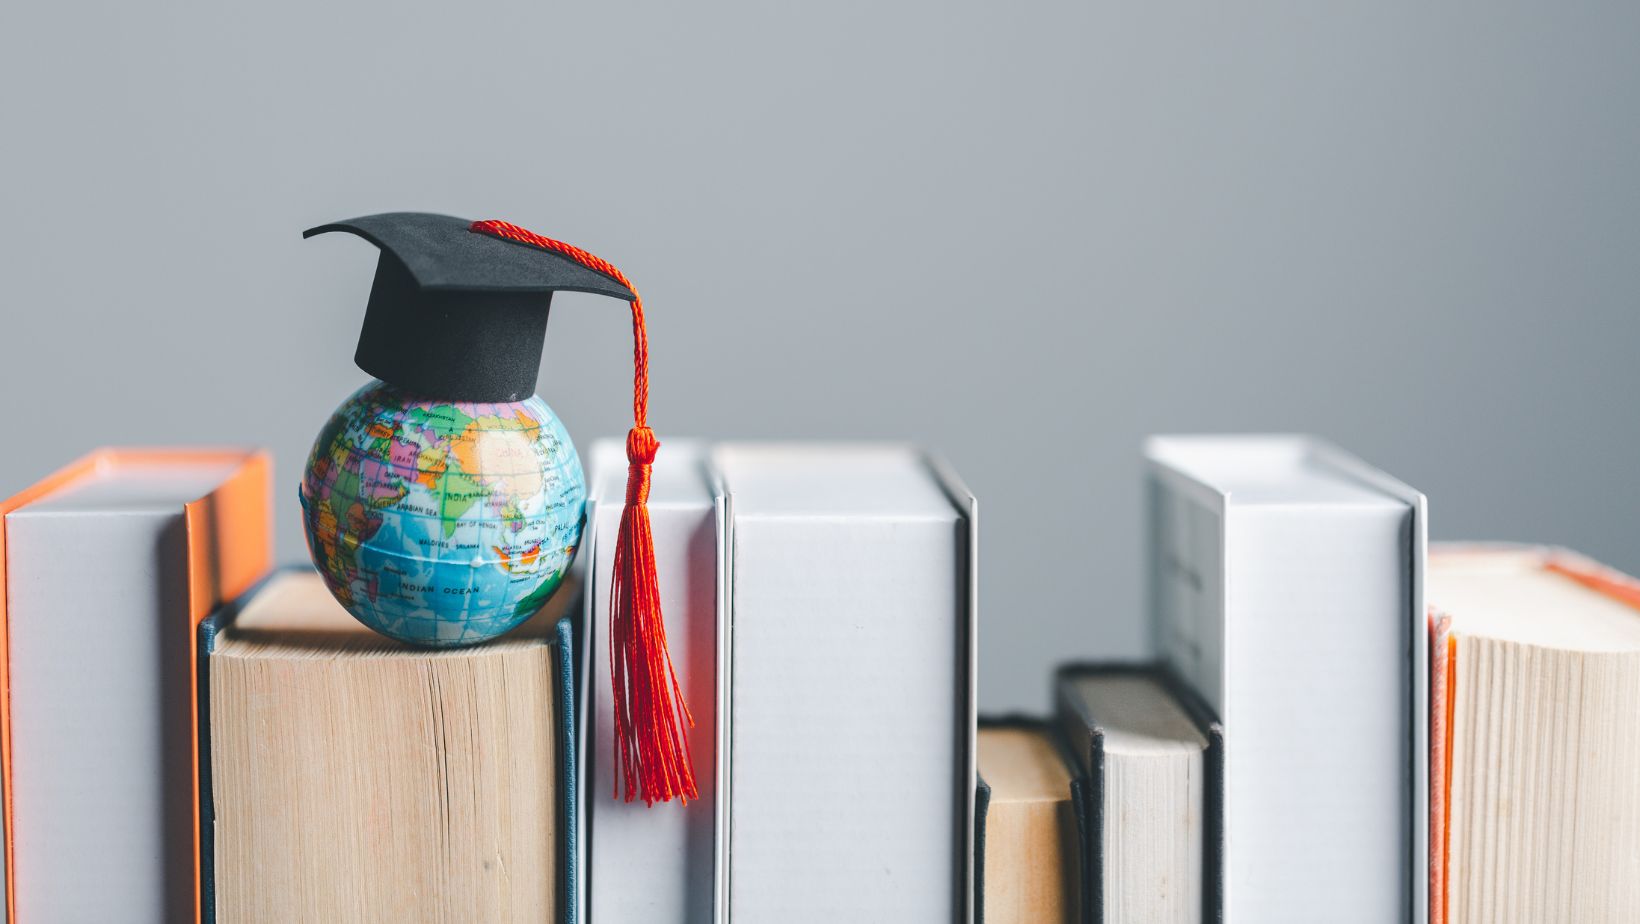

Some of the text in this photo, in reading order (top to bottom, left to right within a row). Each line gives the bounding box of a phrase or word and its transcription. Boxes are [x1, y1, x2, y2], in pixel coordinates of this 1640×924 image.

[393, 455, 412, 464] IRAN
[444, 493, 467, 503] INDIA
[396, 503, 438, 517] ARABIAN SEA
[418, 538, 449, 549] MALDIVES
[399, 582, 480, 596] INDIAN OCEAN
